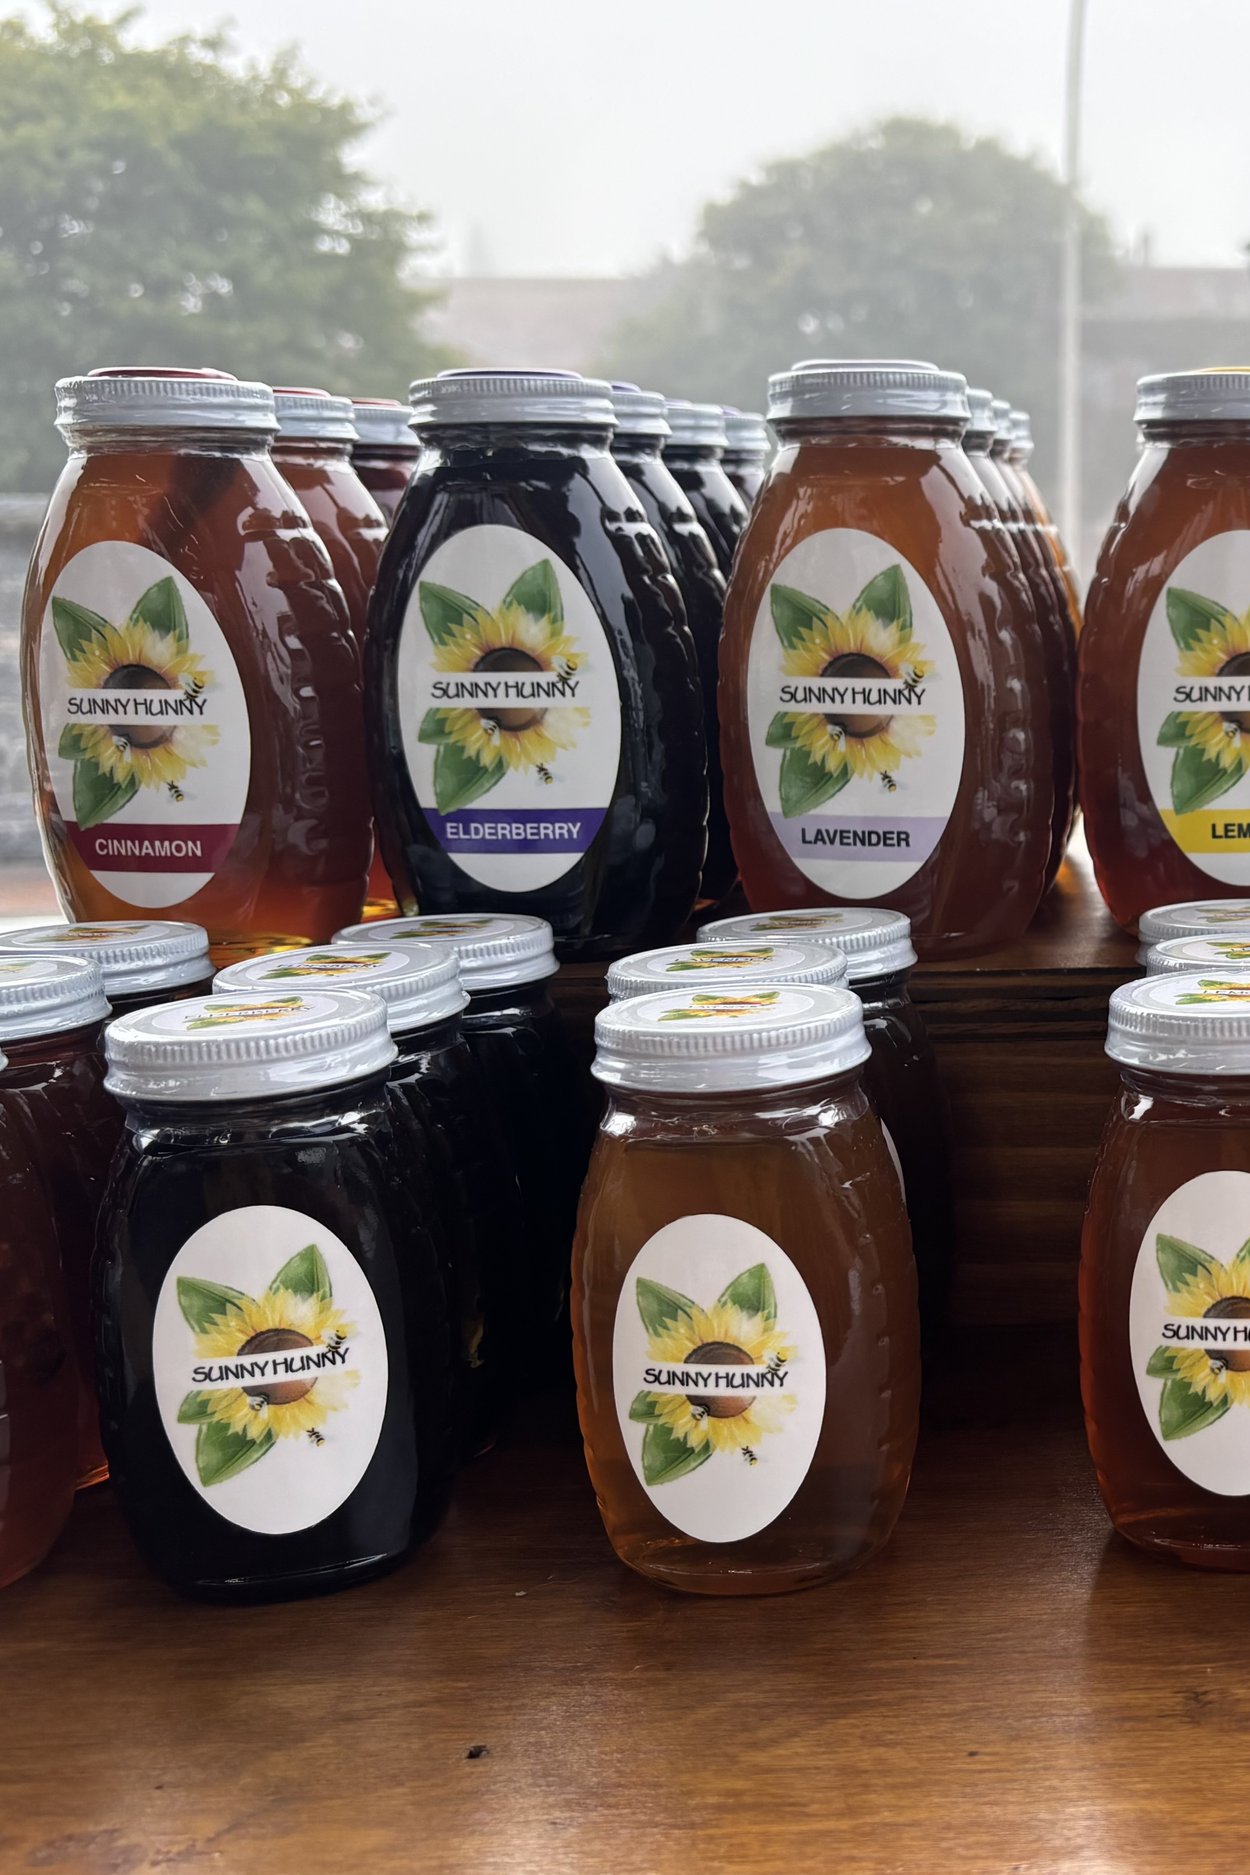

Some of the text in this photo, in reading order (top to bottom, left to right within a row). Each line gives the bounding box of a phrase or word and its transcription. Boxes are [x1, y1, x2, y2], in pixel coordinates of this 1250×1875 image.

[431, 681, 580, 699] SUNNY HUNNY
[779, 685, 926, 706] SUNNY HUNNY
[1173, 685, 1246, 703] SUNNY
[67, 697, 208, 717] SUNNY HUNNY
[445, 822, 582, 841] ELDERBERRY
[800, 827, 911, 849] LAVENDER
[95, 838, 203, 858] CINNAMON
[1161, 1323, 1231, 1342] SUNNY
[191, 1347, 350, 1383] SUNNY HUNNY
[643, 1368, 789, 1389] SUNNY HUNNY
